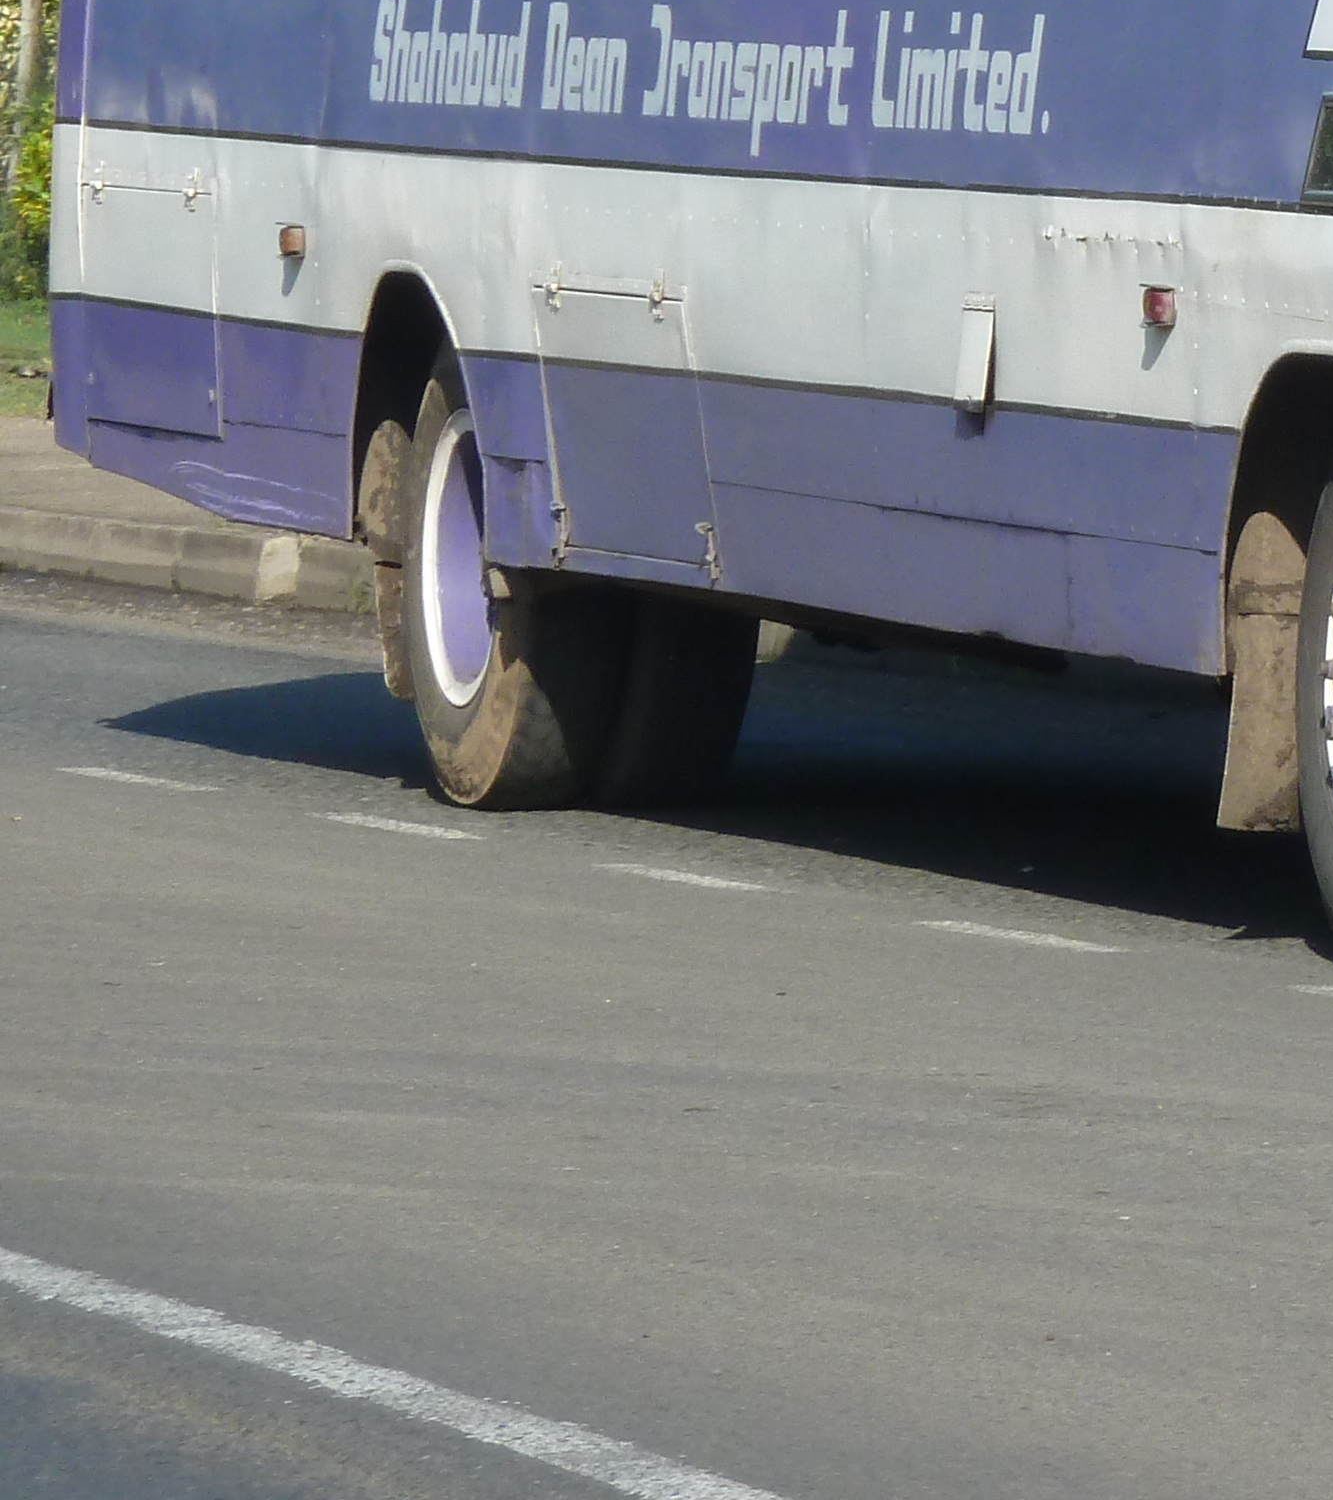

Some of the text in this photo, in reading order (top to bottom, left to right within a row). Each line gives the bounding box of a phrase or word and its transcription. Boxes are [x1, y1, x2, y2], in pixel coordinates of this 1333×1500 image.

[541, 1, 627, 114] Dean
[642, 3, 855, 157] Transport
[872, 10, 1050, 135] Limited.
